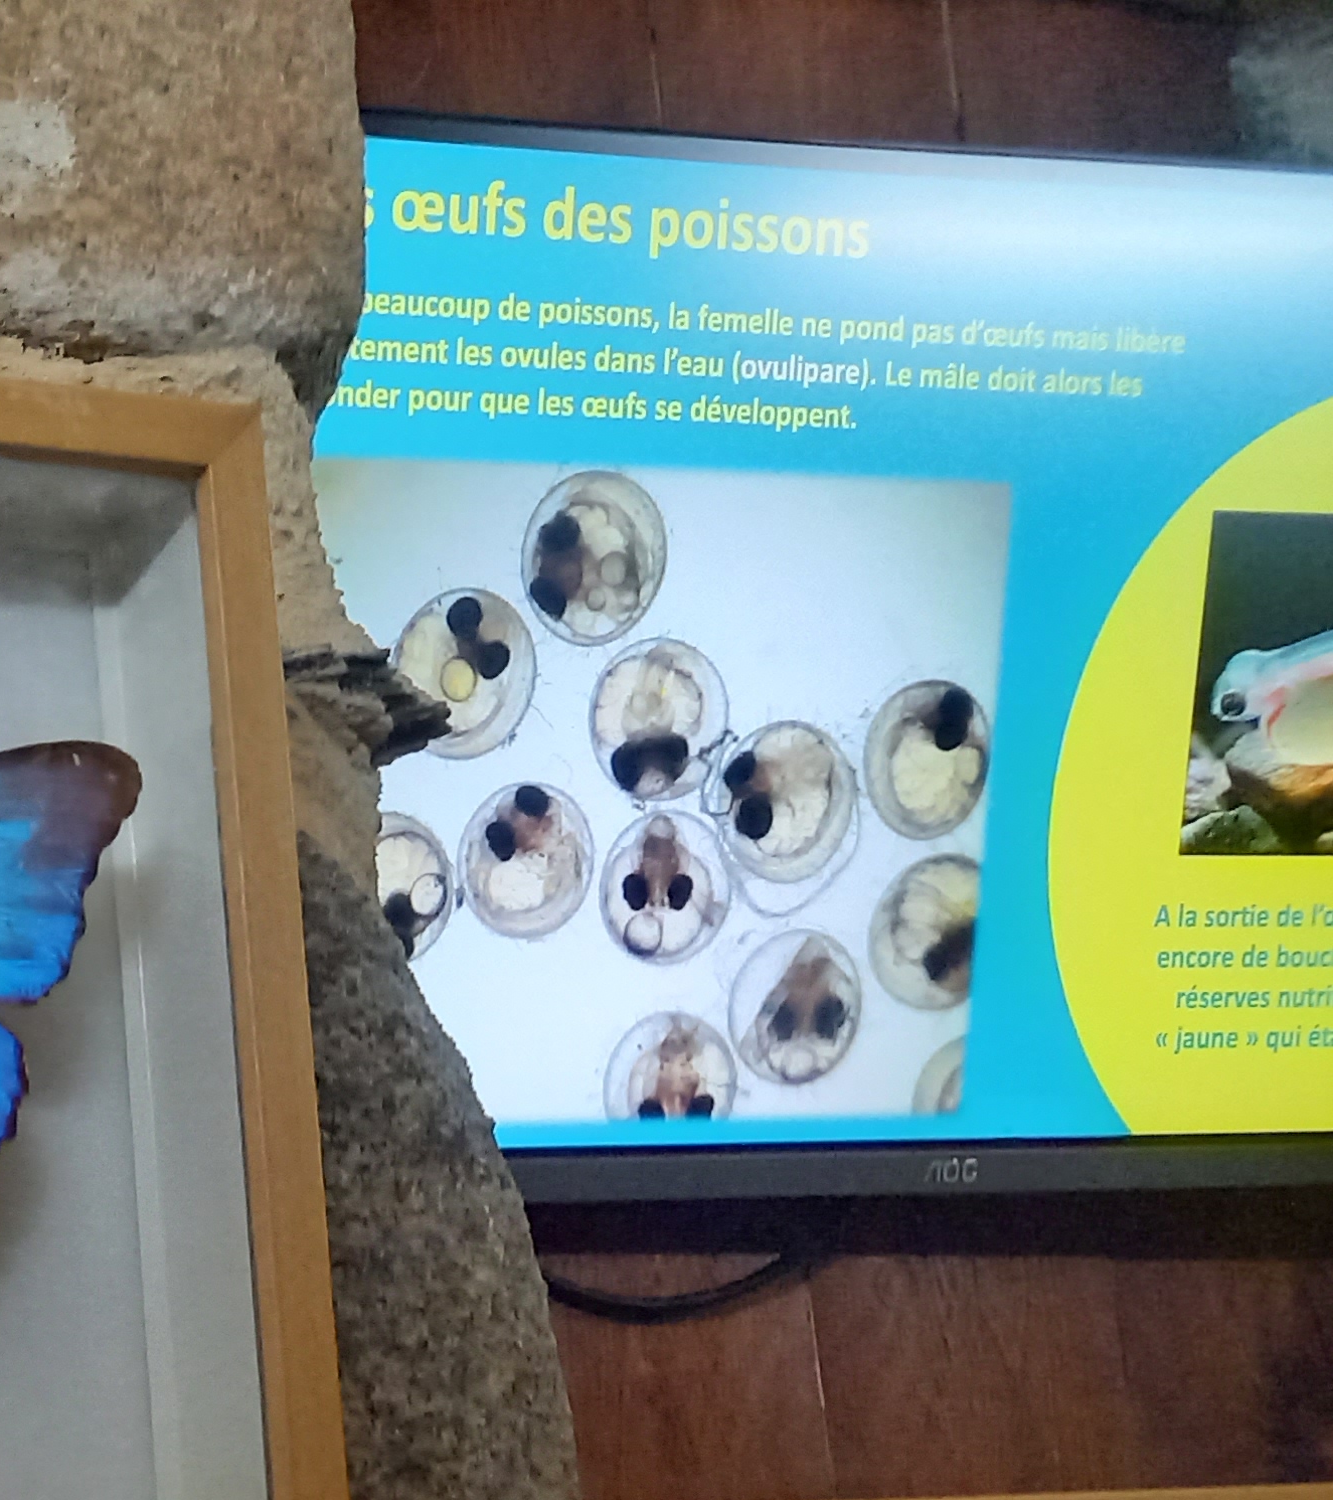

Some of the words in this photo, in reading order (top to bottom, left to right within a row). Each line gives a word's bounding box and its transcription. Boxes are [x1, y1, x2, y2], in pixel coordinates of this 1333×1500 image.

[392, 180, 527, 238] œufs
[543, 186, 633, 245] des
[649, 198, 870, 259] poissons
[498, 293, 531, 322] de
[538, 297, 660, 335] poissons,
[668, 301, 690, 330] la
[698, 303, 794, 337] femelle
[801, 314, 832, 338] ne
[839, 315, 904, 345] pond
[911, 321, 955, 349] pas
[1051, 327, 1110, 353] mais
[1115, 326, 1186, 355] libère
[456, 336, 493, 368] les
[501, 341, 587, 372] ovules
[594, 345, 655, 375] dans
[732, 349, 876, 392] (ovulipare).
[885, 359, 912, 388] Le
[919, 362, 980, 391] mâle
[987, 364, 1037, 394] doit
[1042, 366, 1103, 396] alors
[1107, 370, 1142, 398] les
[408, 387, 472, 417] pour
[479, 391, 530, 420] que
[538, 386, 574, 418] les
[581, 389, 647, 422] œufs
[654, 398, 682, 422] se
[690, 390, 858, 433] développent.
[1153, 904, 1171, 928] A
[1177, 903, 1197, 928] la
[1204, 904, 1270, 928] sortie
[1276, 903, 1304, 928] de
[1157, 949, 1235, 969] encore
[1241, 944, 1270, 968] de
[1175, 984, 1271, 1009] réserves
[1155, 1031, 1168, 1048] «
[1174, 1026, 1239, 1055] jaune
[1246, 1031, 1259, 1047] »
[1265, 1025, 1301, 1053] qui
